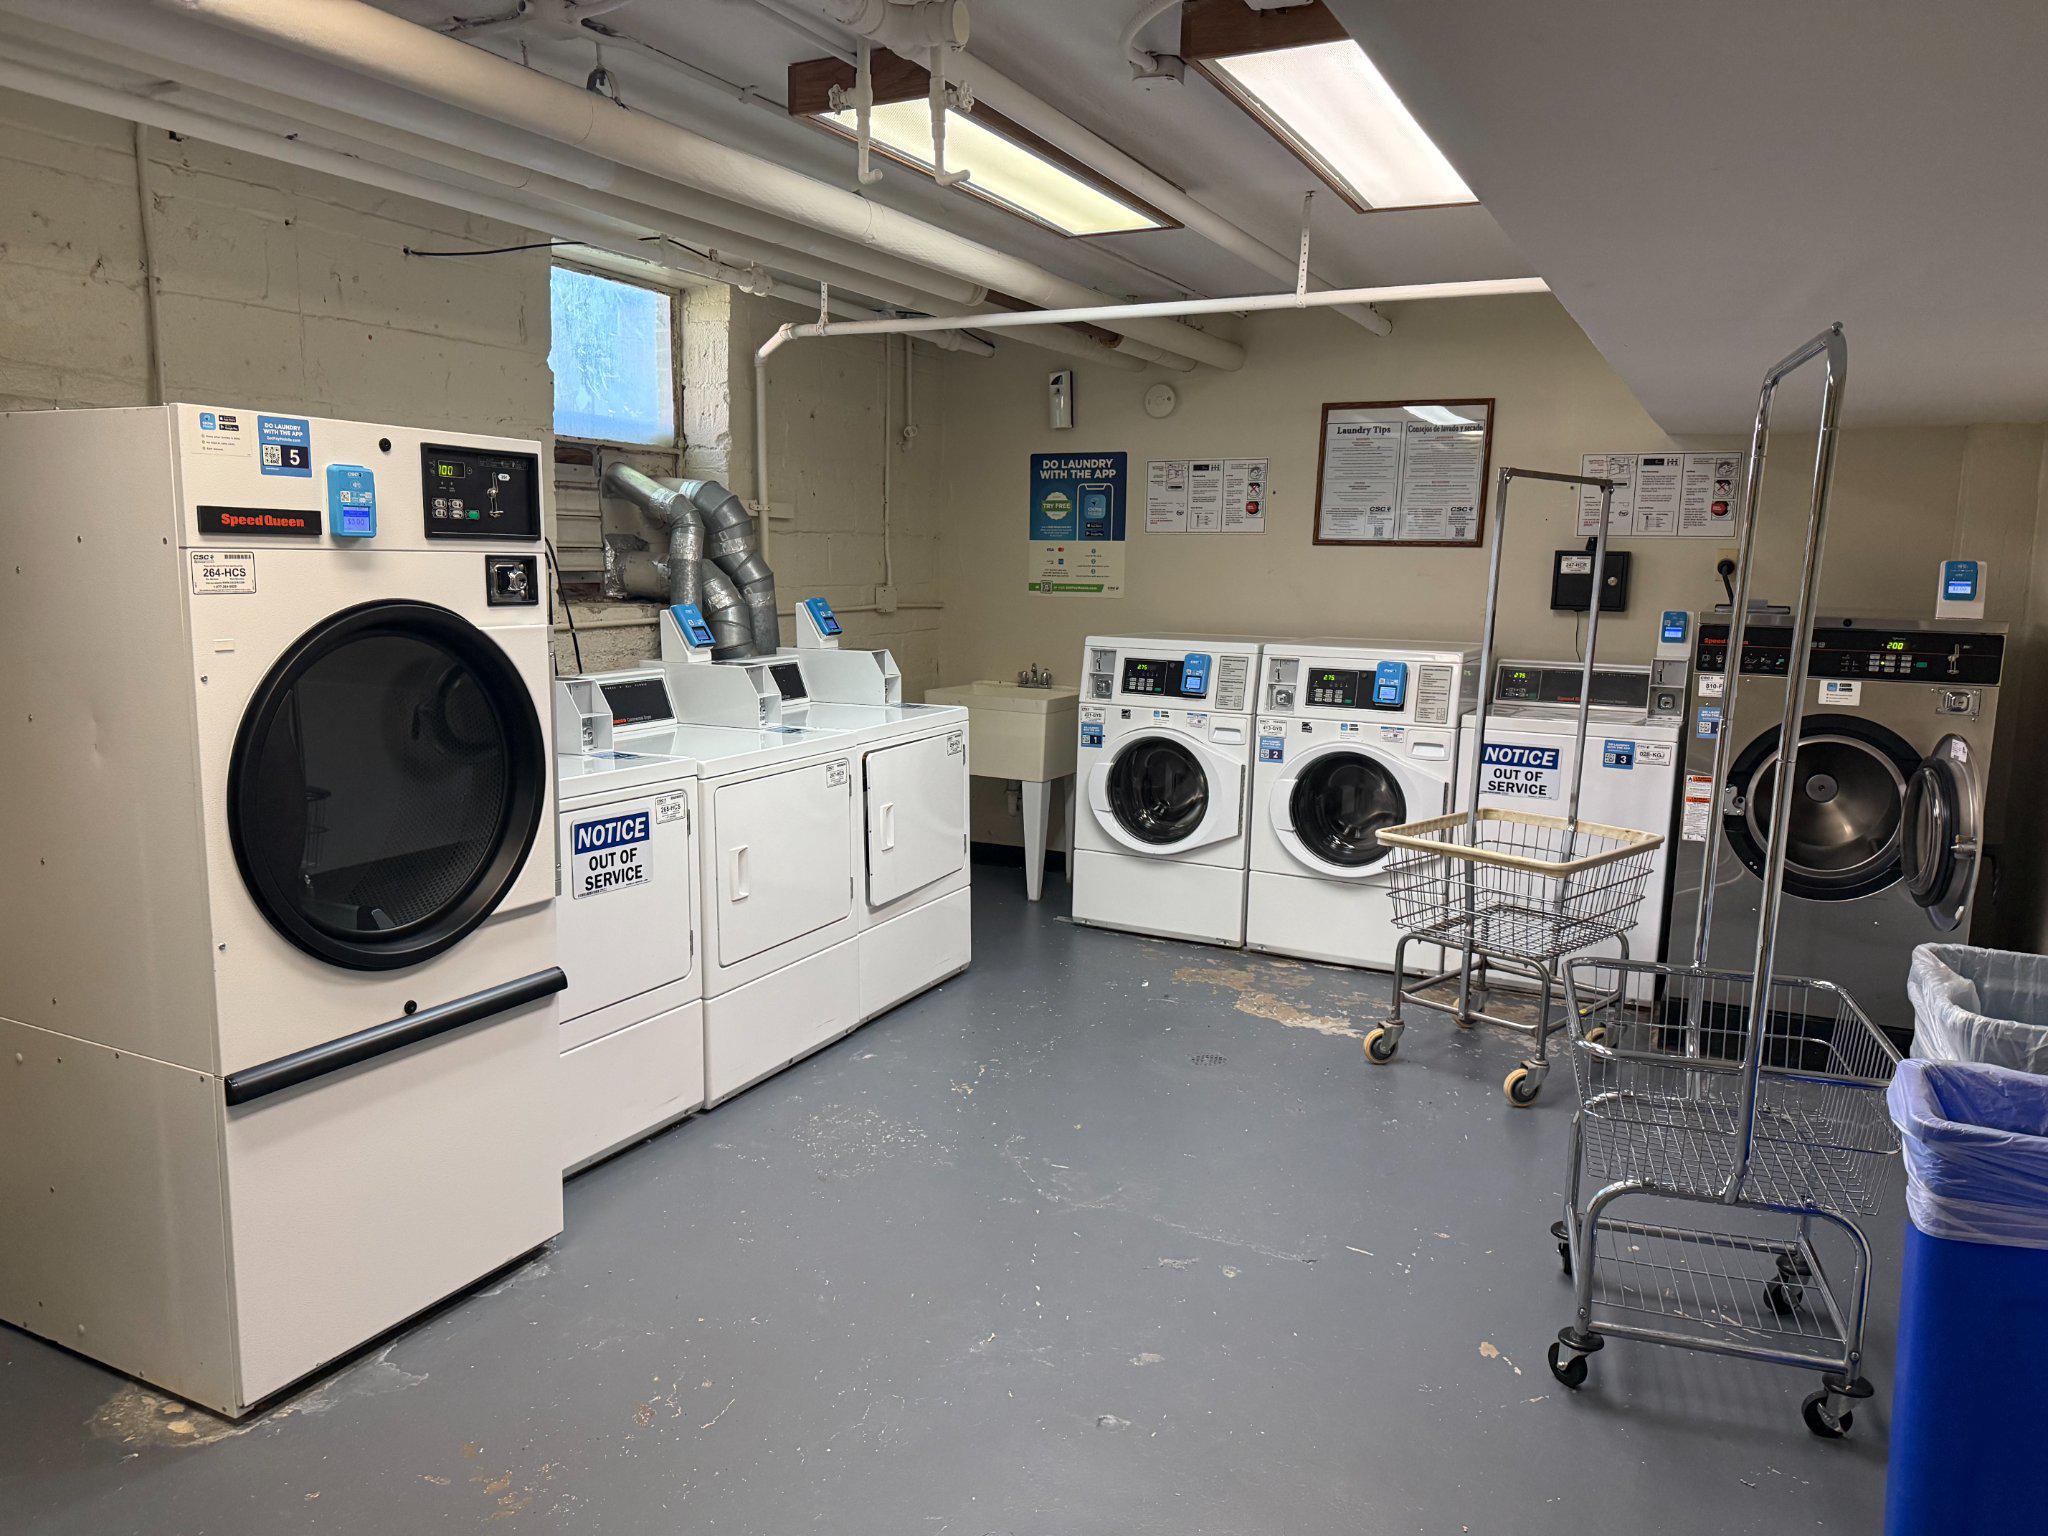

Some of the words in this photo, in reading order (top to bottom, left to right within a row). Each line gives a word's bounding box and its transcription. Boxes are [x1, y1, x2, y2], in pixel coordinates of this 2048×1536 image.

[1337, 426, 1372, 436] Laundry
[1373, 425, 1391, 435] Tips
[1408, 425, 1433, 436] Consejos
[1433, 424, 1440, 432] de
[1440, 424, 1459, 432] lavado
[1464, 424, 1484, 432] secado
[290, 449, 300, 465] 5
[1043, 460, 1059, 469] DO
[1061, 458, 1113, 469] LAUNDRY
[1039, 470, 1068, 479] WITH
[1070, 469, 1092, 479] THE
[1094, 469, 1116, 479] APP
[221, 513, 264, 527] Speed
[264, 514, 305, 527] Queen
[203, 568, 246, 578] 264-HCS
[1886, 642, 1904, 650] 200
[1272, 750, 1279, 759] 2
[1484, 746, 1556, 767] NOTICE
[1620, 755, 1627, 764] 3
[1493, 768, 1521, 781] OUT
[1524, 770, 1543, 782] OF
[1487, 780, 1547, 796] SERVICE
[577, 817, 646, 850] NOTICE
[588, 851, 616, 871] OUT
[619, 847, 638, 865] OF
[585, 864, 643, 891] SERVICE
